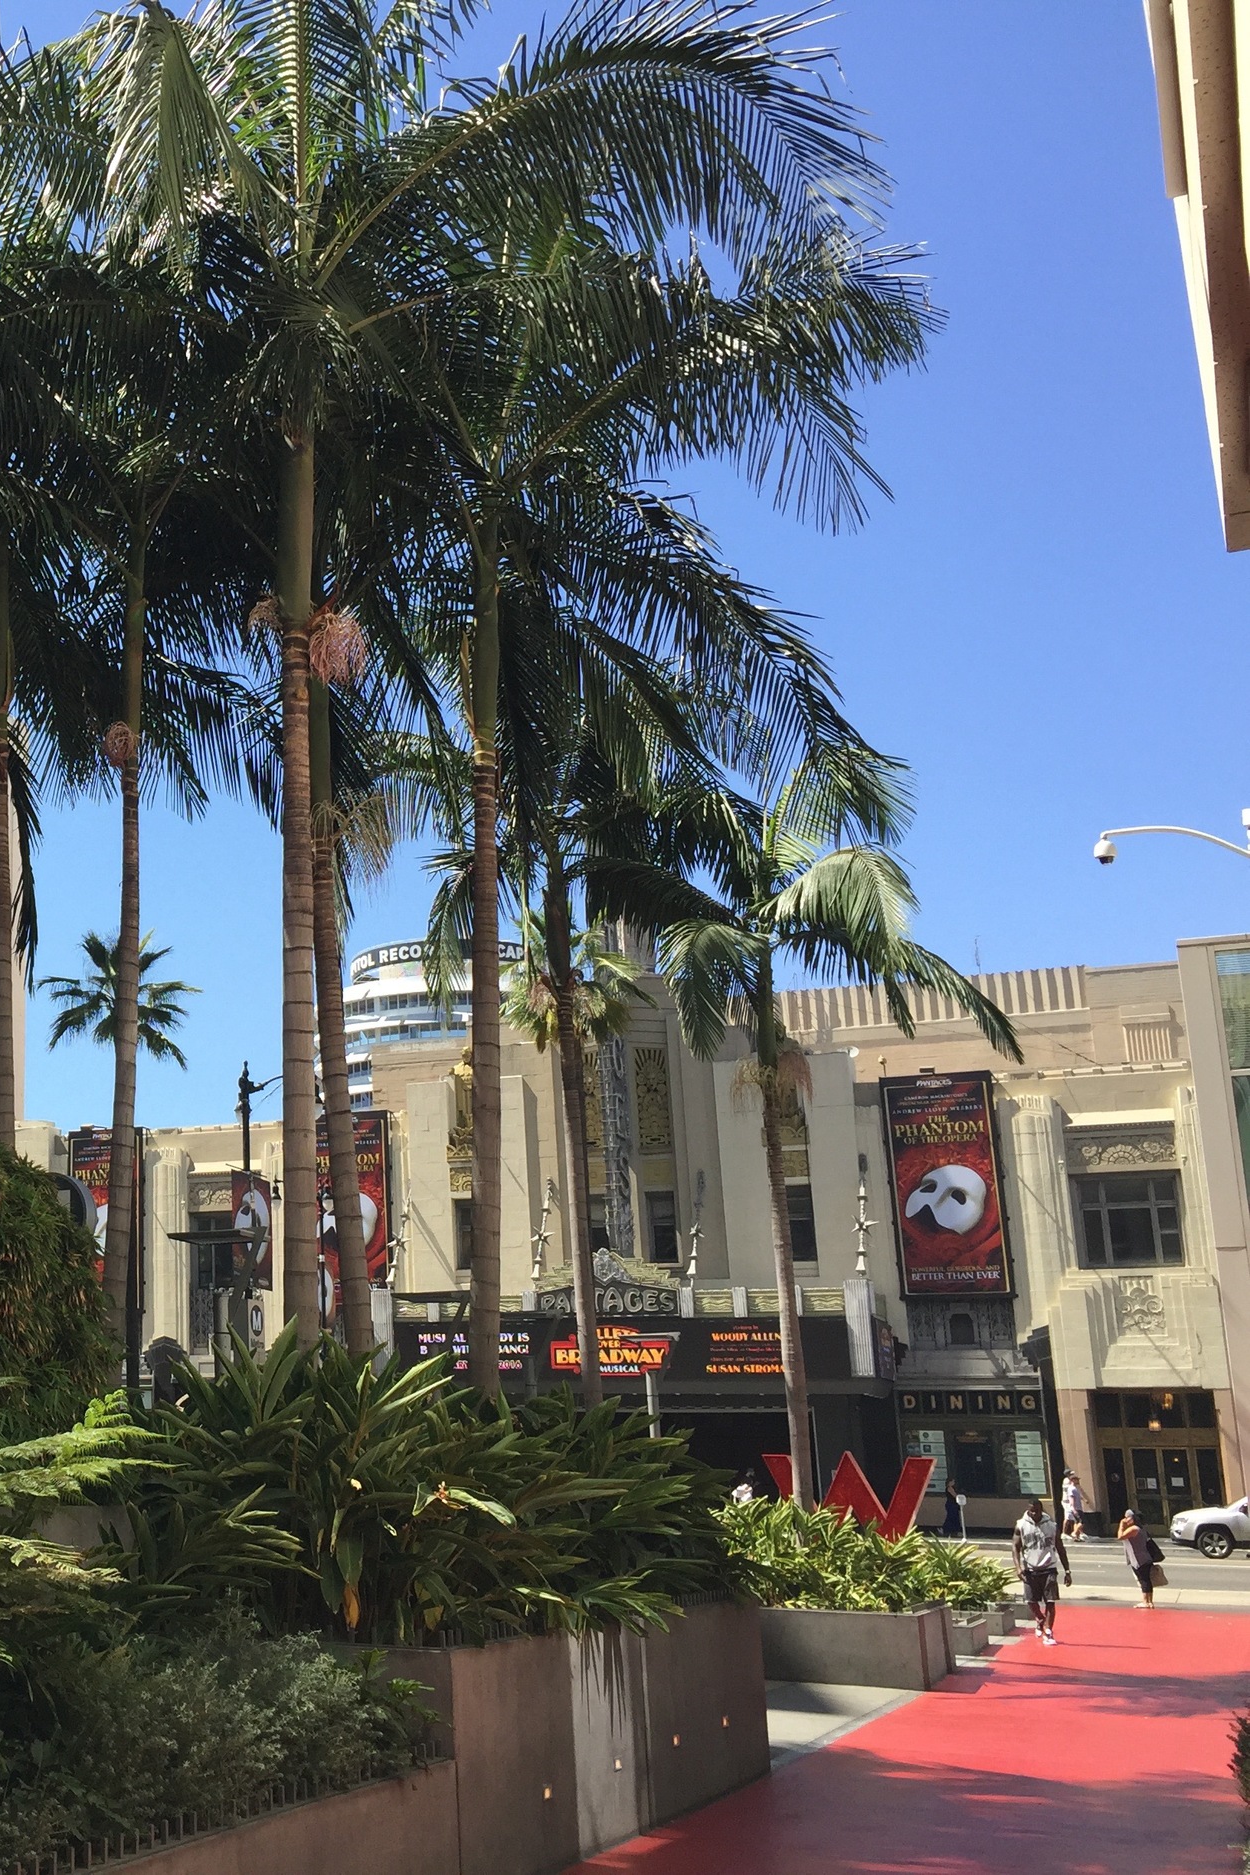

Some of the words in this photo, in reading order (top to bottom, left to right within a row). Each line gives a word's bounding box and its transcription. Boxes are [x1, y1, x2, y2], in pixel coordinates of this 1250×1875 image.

[927, 1114, 950, 1123] THE
[894, 1120, 985, 1138] PHANTOM
[903, 1137, 918, 1145] OF
[922, 1134, 942, 1144] THE
[942, 1133, 978, 1142] OPERA
[74, 1169, 109, 1180] PHAN
[912, 1272, 945, 1281] BETTER
[946, 1271, 974, 1280] THAN
[541, 1286, 676, 1313] PATAGES
[252, 1310, 263, 1331] M
[417, 1332, 467, 1344] MUSIAL
[517, 1332, 530, 1343] IS
[711, 1332, 749, 1342] WOODY
[751, 1332, 782, 1342] ALLEN
[555, 1348, 666, 1365] BRADWAY
[705, 1364, 742, 1374] SUSAN
[743, 1364, 786, 1374] STROMA
[903, 1394, 1036, 1411] DINING
[761, 1450, 938, 1545] W
